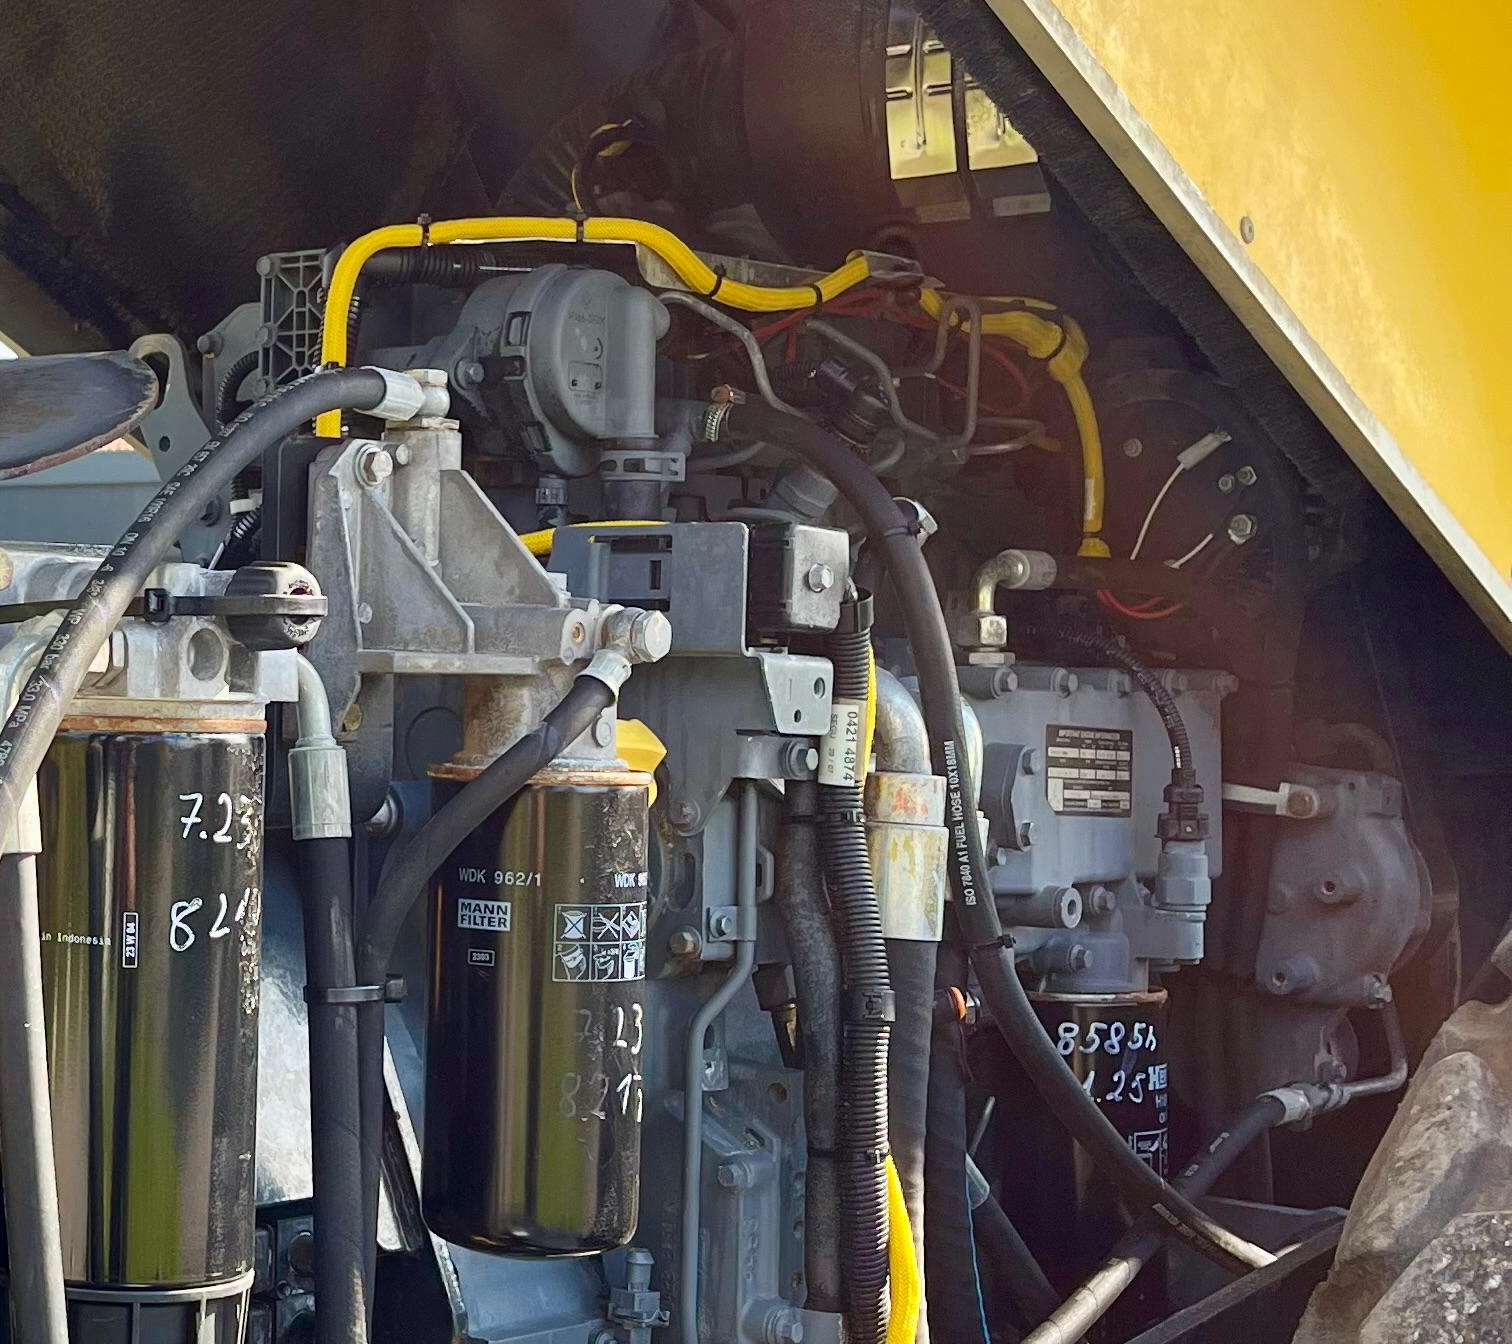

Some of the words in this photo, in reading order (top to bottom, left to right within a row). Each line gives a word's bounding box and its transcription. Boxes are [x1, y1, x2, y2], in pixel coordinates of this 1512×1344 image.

[950, 791, 964, 821] HOSE
[955, 823, 968, 849] FUEL
[957, 850, 970, 863] A1
[459, 867, 486, 884] WDK
[494, 871, 542, 887] 962/1
[965, 888, 977, 906] ISO
[460, 901, 508, 916] MANN
[460, 914, 508, 929] FILTER
[57, 932, 112, 946] Indonesia
